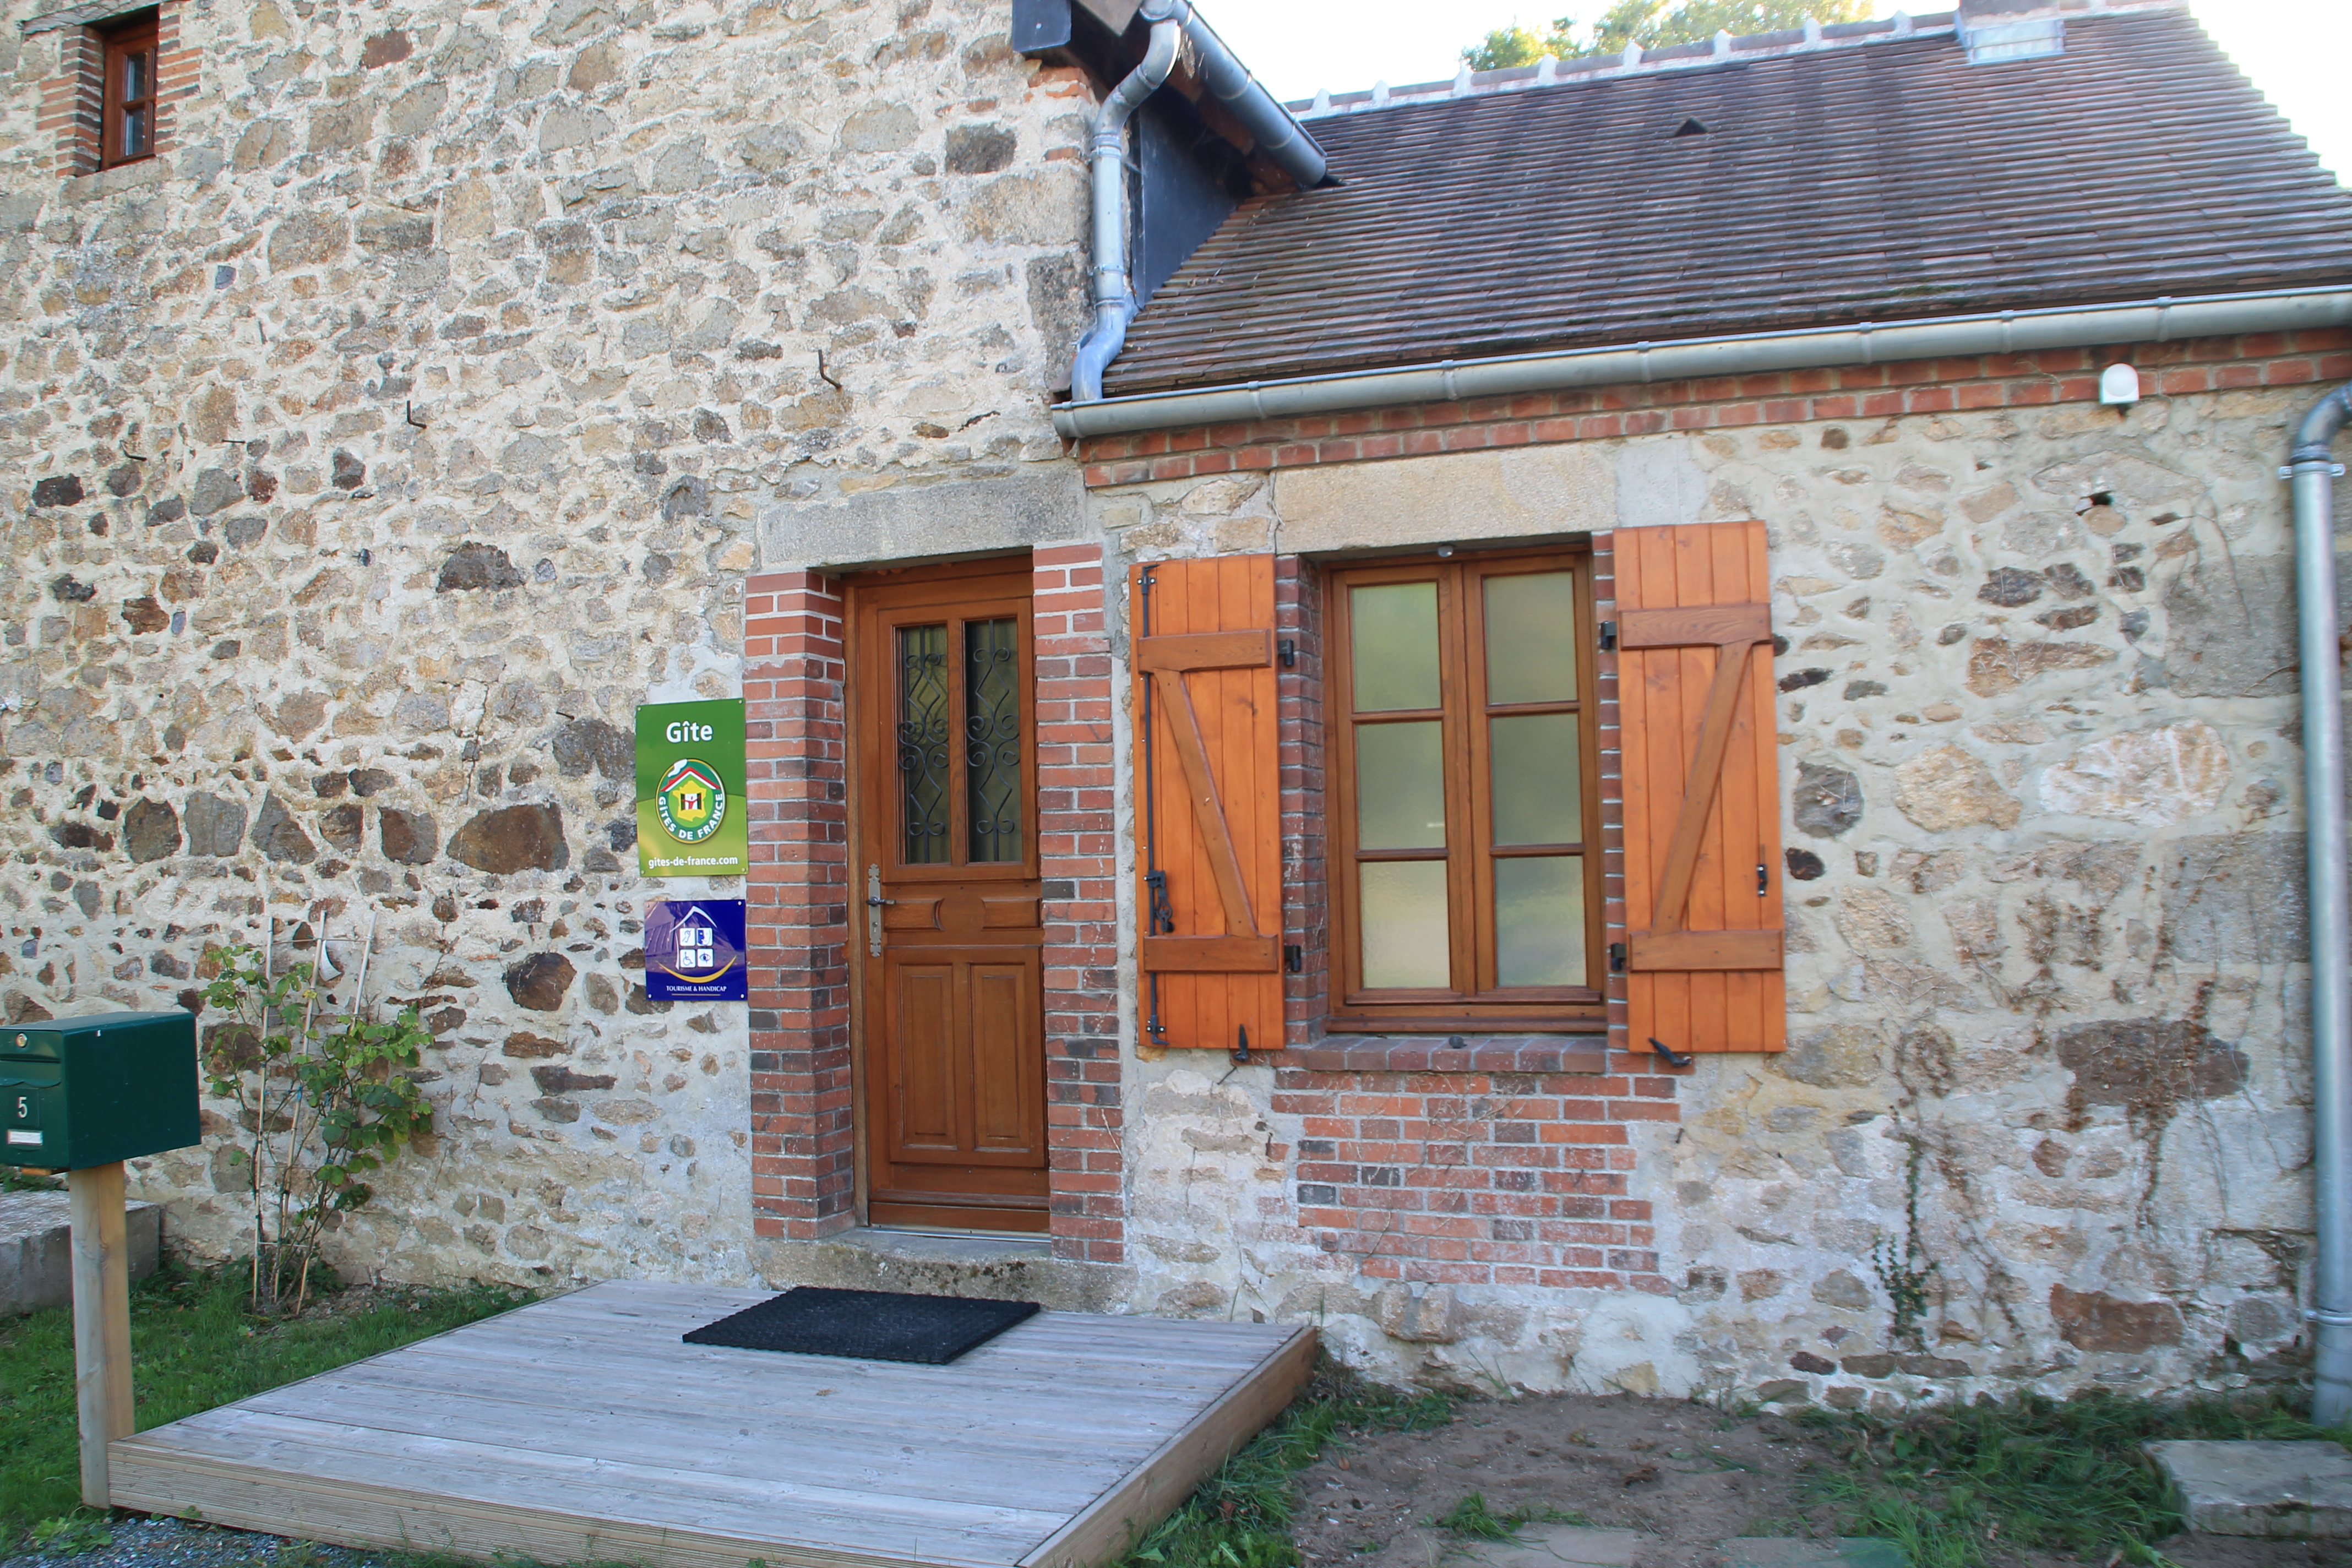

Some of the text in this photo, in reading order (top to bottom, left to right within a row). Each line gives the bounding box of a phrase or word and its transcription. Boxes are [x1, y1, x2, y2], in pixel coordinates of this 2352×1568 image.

[666, 720, 713, 743] Gîte
[678, 829, 693, 840] DE
[697, 793, 723, 838] FRANCE
[649, 856, 738, 869] gites-de-france.com
[18, 1097, 28, 1118] 5
